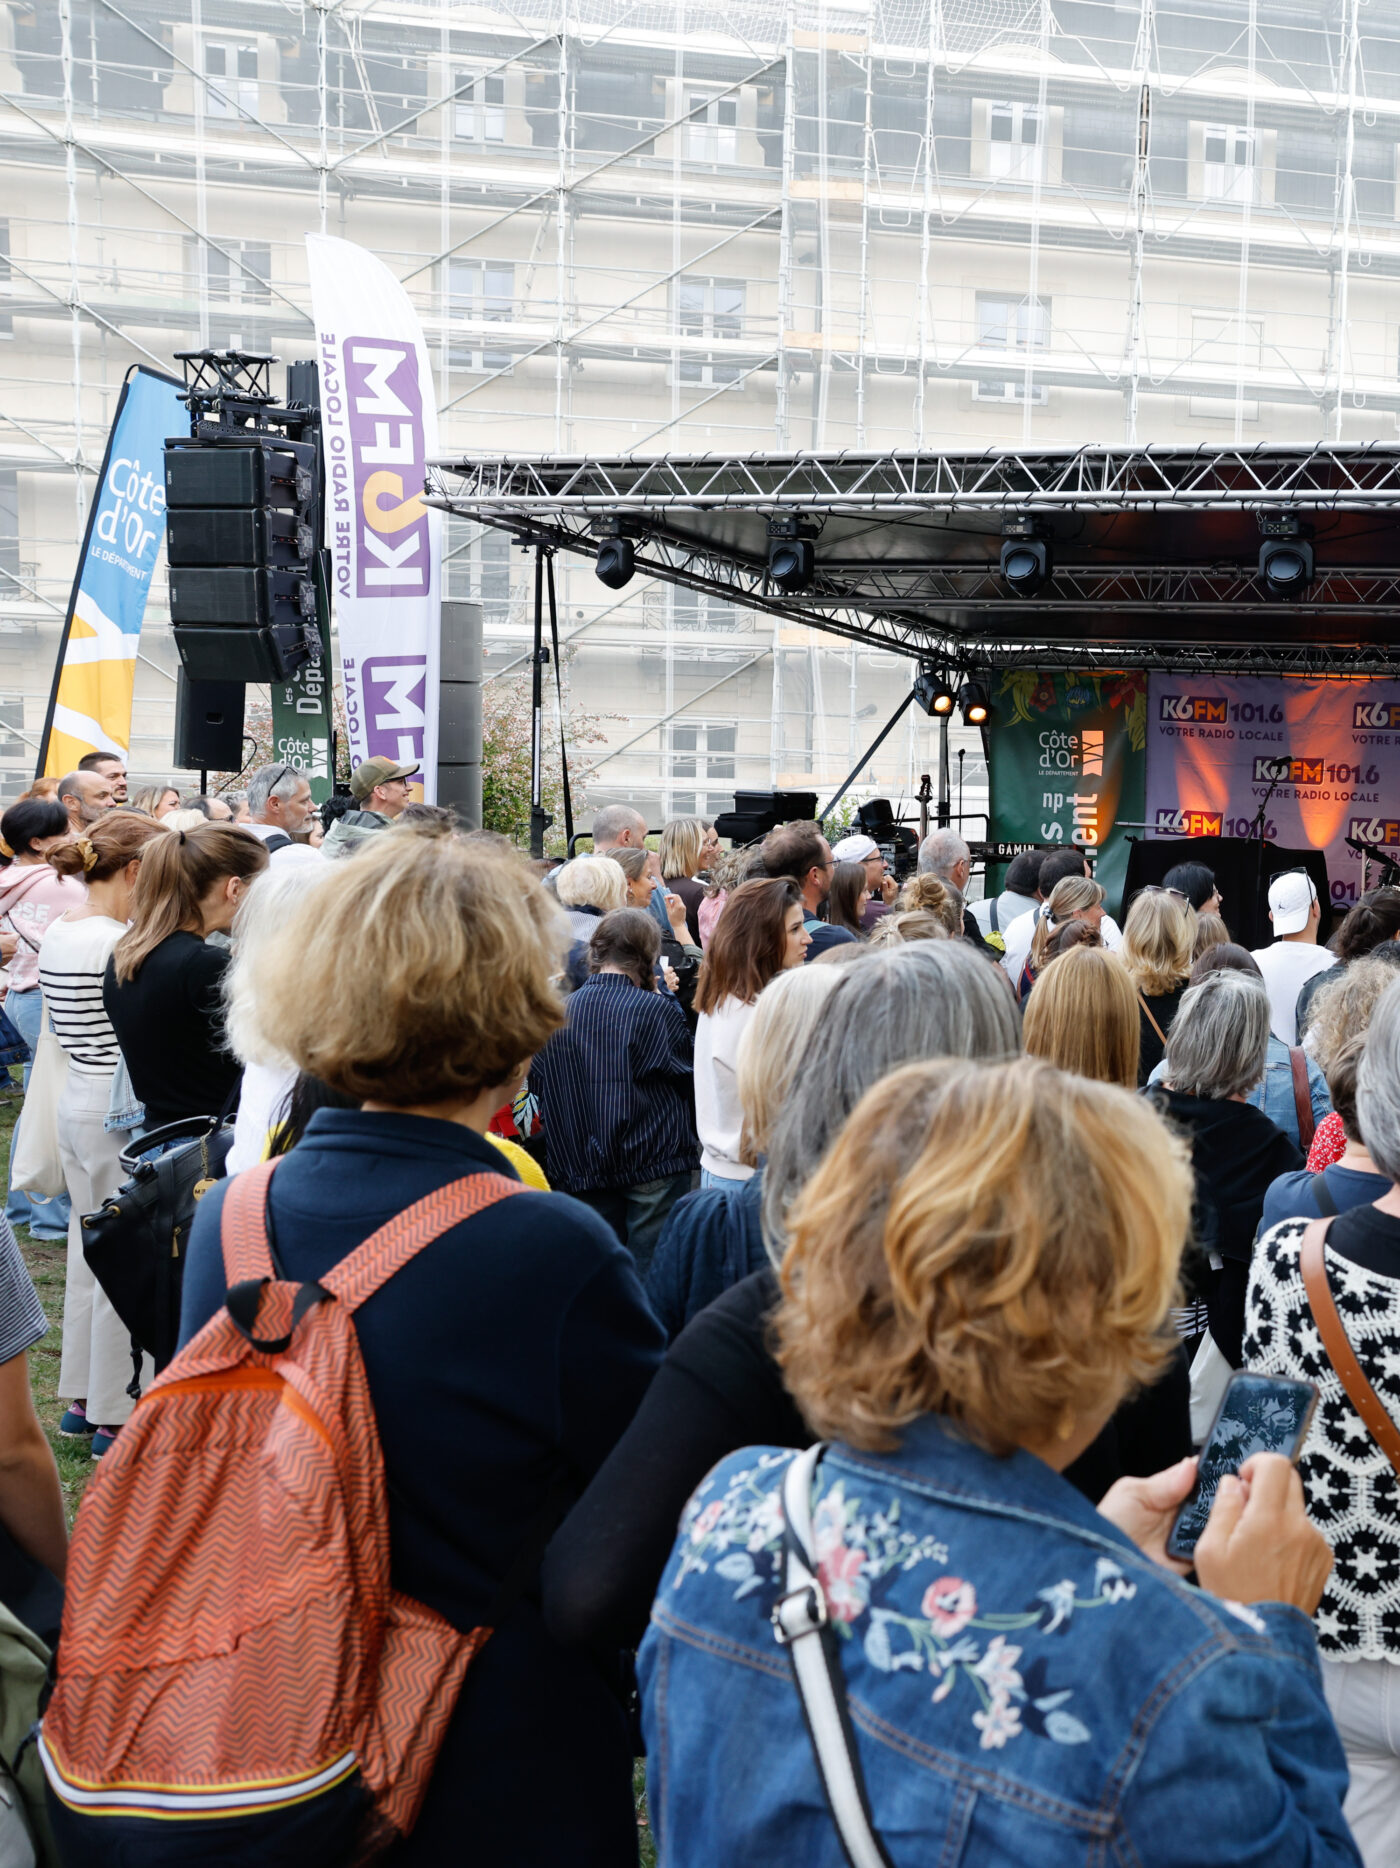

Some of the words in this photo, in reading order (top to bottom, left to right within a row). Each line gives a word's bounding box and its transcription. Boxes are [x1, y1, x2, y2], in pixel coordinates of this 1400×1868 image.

[108, 457, 167, 517] Côte
[96, 498, 157, 559] d'Or
[90, 545, 101, 559] LE
[283, 687, 294, 706] les
[1162, 695, 1226, 722] K6FM
[1230, 702, 1284, 724] 101.6
[1038, 729, 1079, 749] Côte
[1159, 726, 1195, 738] VOTRE
[1199, 729, 1235, 740] RADIO
[1239, 730, 1284, 742] LOCALE
[1352, 734, 1391, 746] VOTRE
[278, 737, 310, 755] Côte
[1039, 748, 1079, 768] d'Or
[1045, 769, 1079, 777] DÉPARTEMENT
[1326, 763, 1380, 785] 101.6
[1251, 787, 1291, 799] VOTRE
[1294, 788, 1331, 801] RADIO
[1334, 791, 1380, 803] LOCALE
[1158, 809, 1221, 836] K6FM
